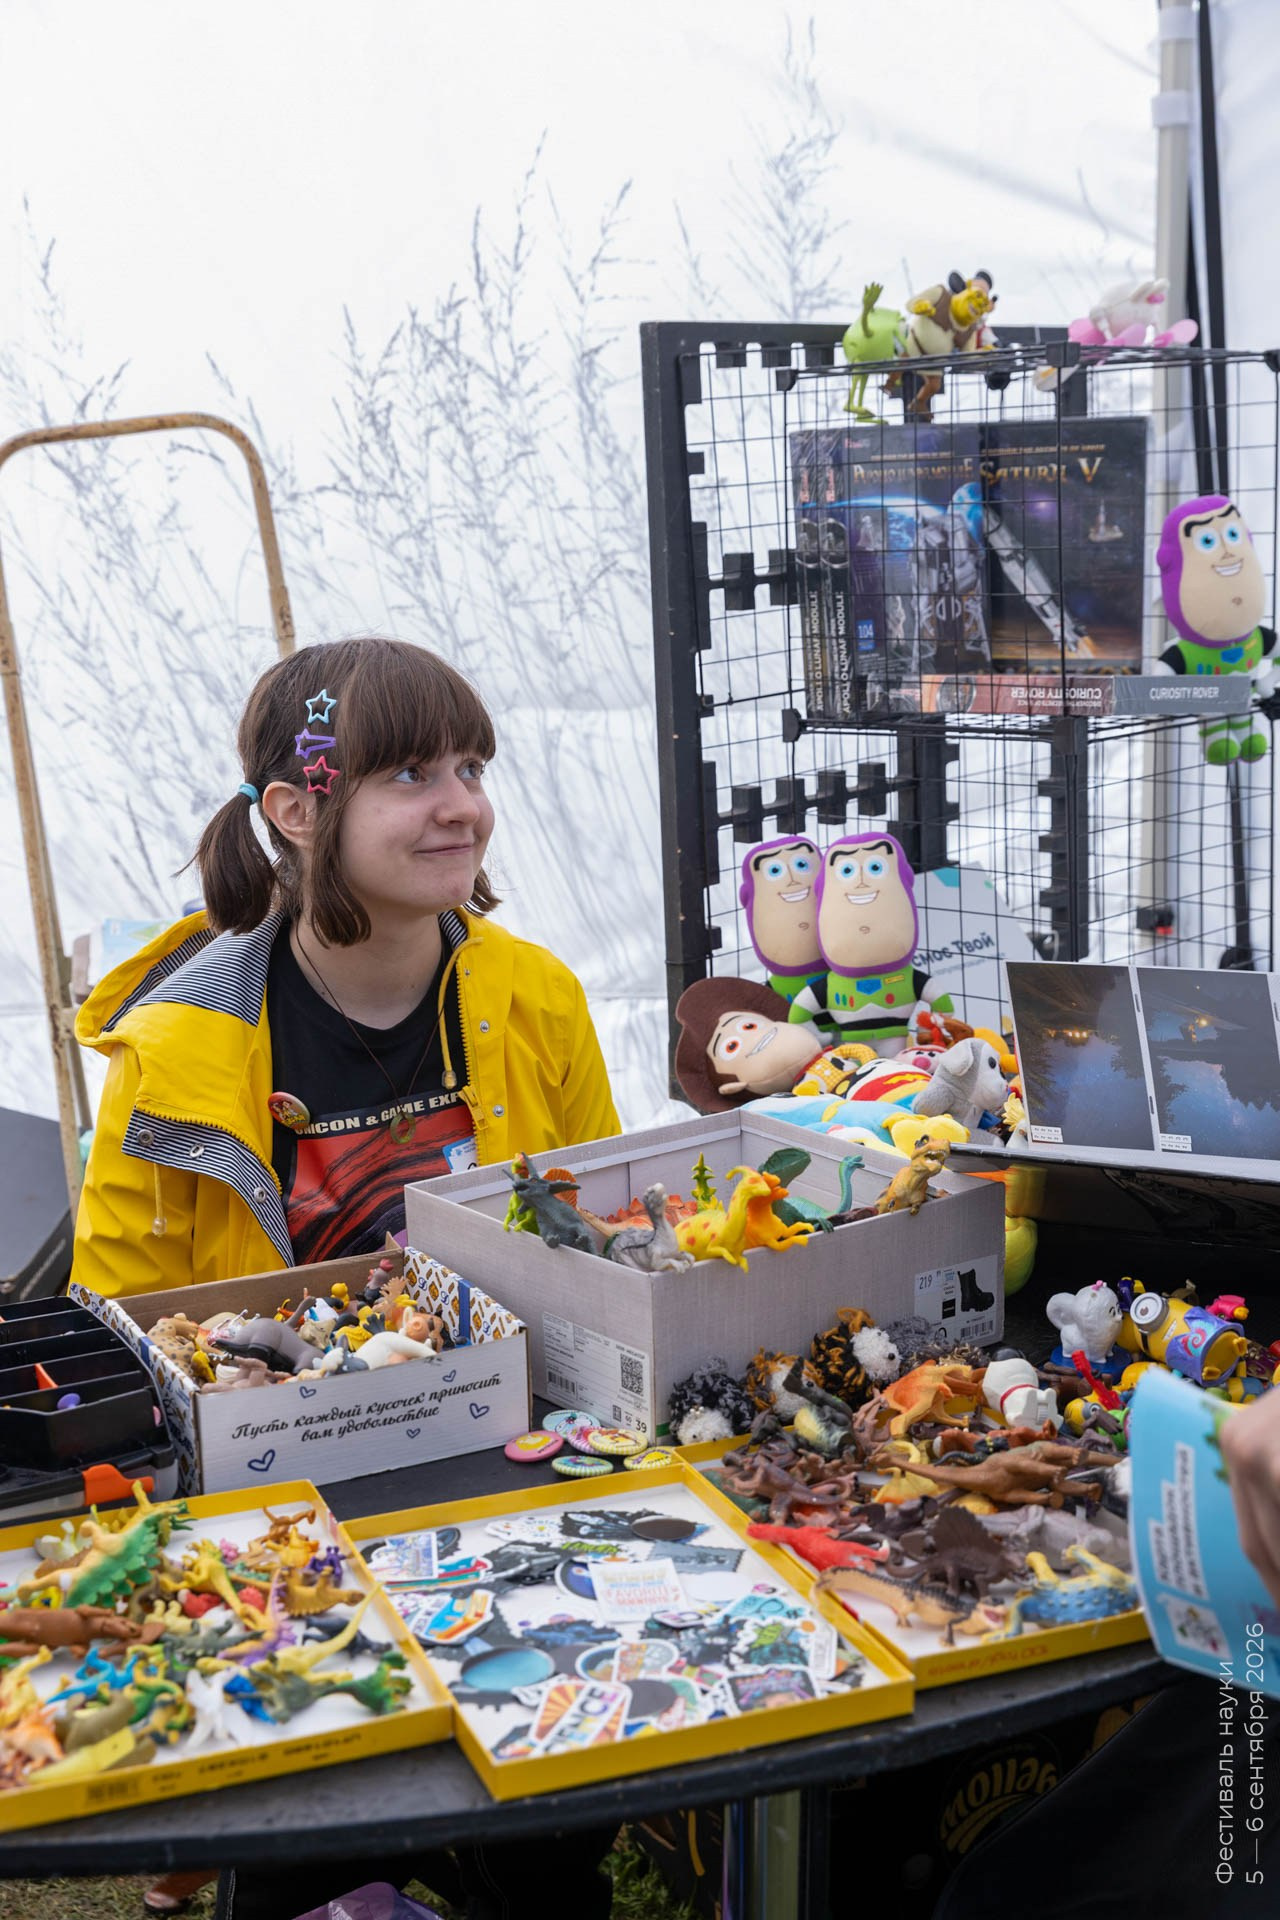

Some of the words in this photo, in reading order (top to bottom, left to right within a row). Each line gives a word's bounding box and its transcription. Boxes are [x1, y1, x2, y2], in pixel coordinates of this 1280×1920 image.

[1077, 456, 1104, 482] V
[1149, 686, 1192, 700] CURIOSITY
[1192, 686, 1220, 699] ROVER
[365, 1115, 379, 1126] &
[380, 1100, 425, 1122] GAME
[428, 1091, 460, 1109] EXP
[919, 1274, 933, 1290] 219
[232, 1419, 288, 1439] Пусть
[429, 1373, 502, 1403] приносит
[301, 1427, 334, 1442] вам
[338, 1406, 440, 1439] удовольствие
[635, 1419, 647, 1433] 39
